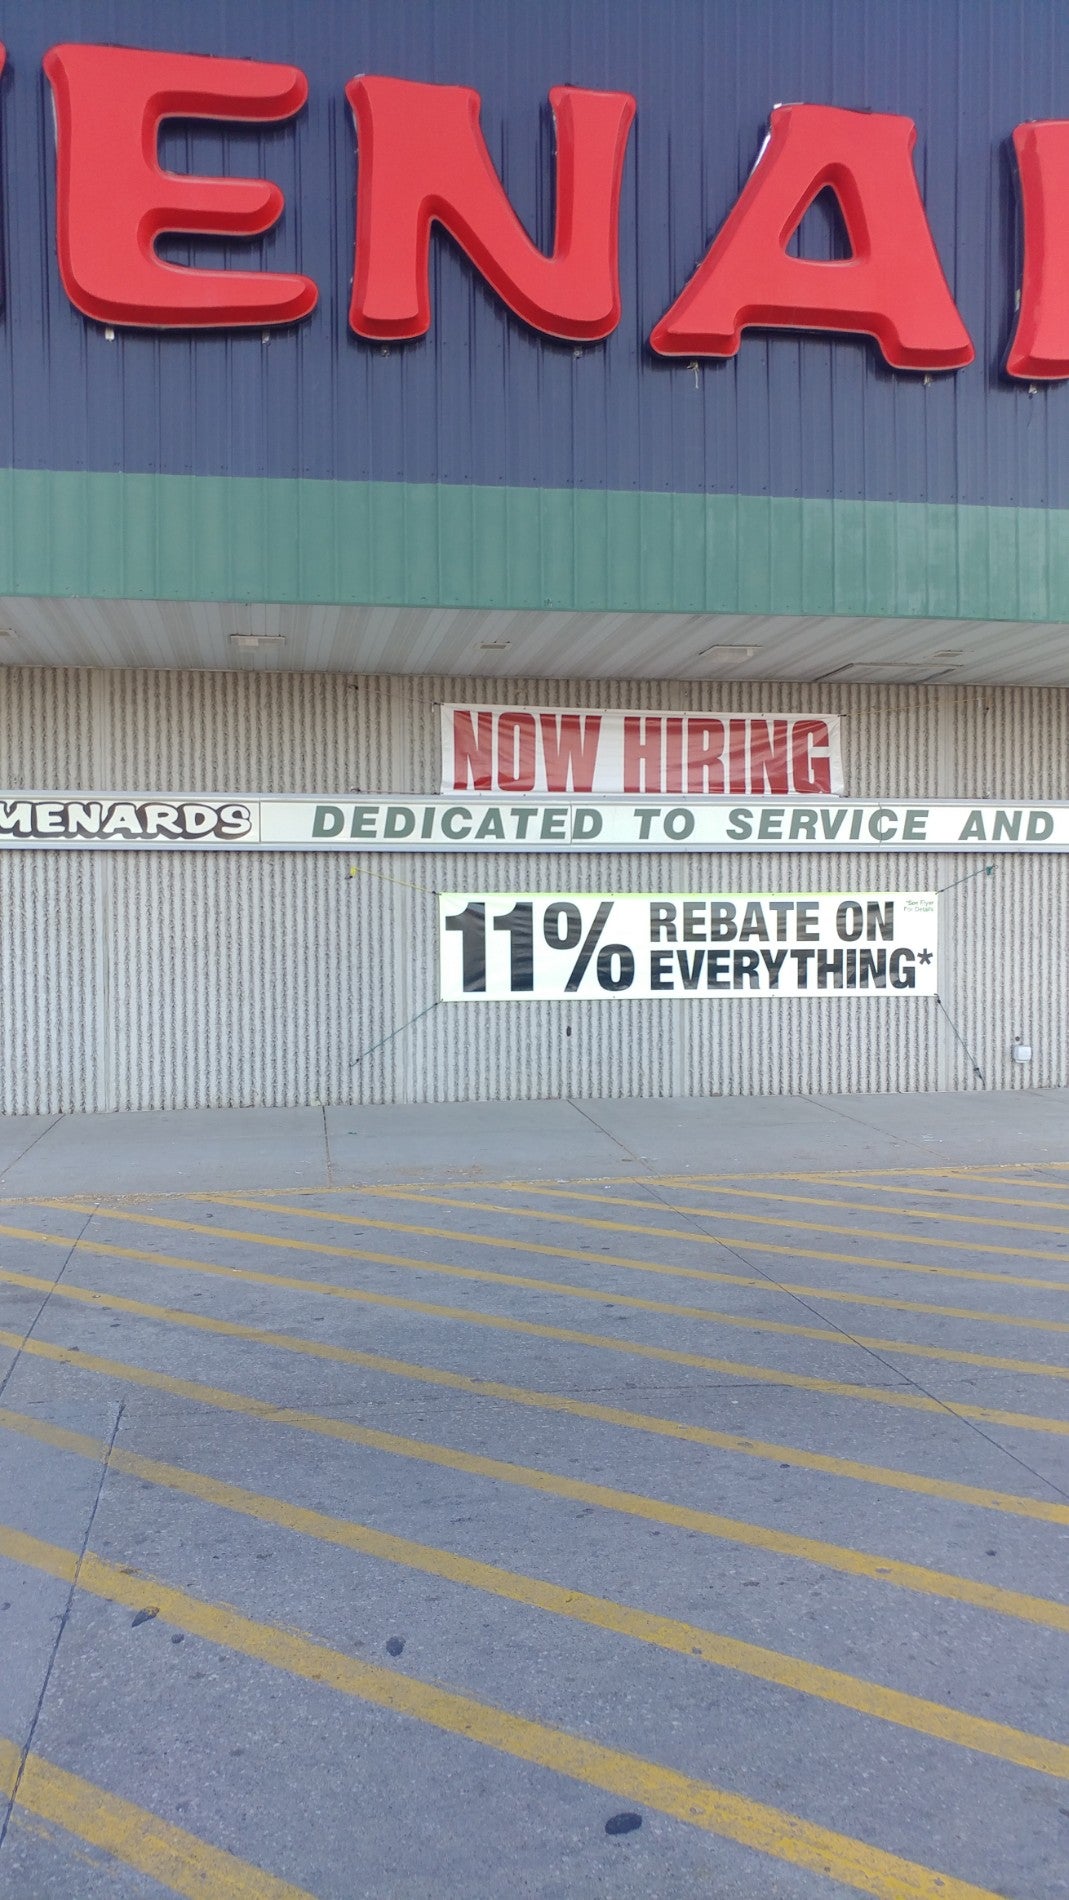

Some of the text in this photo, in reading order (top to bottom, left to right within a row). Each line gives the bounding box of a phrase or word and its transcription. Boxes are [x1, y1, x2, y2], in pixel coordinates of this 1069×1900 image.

[0, 43, 1069, 380] ENA
[453, 709, 831, 795] NOW HIRING
[0, 801, 253, 840] MENARDS
[312, 805, 1055, 841] DEDICATED TO SERVICE AND
[444, 901, 635, 993] 11%
[649, 901, 894, 943] REBATE ON
